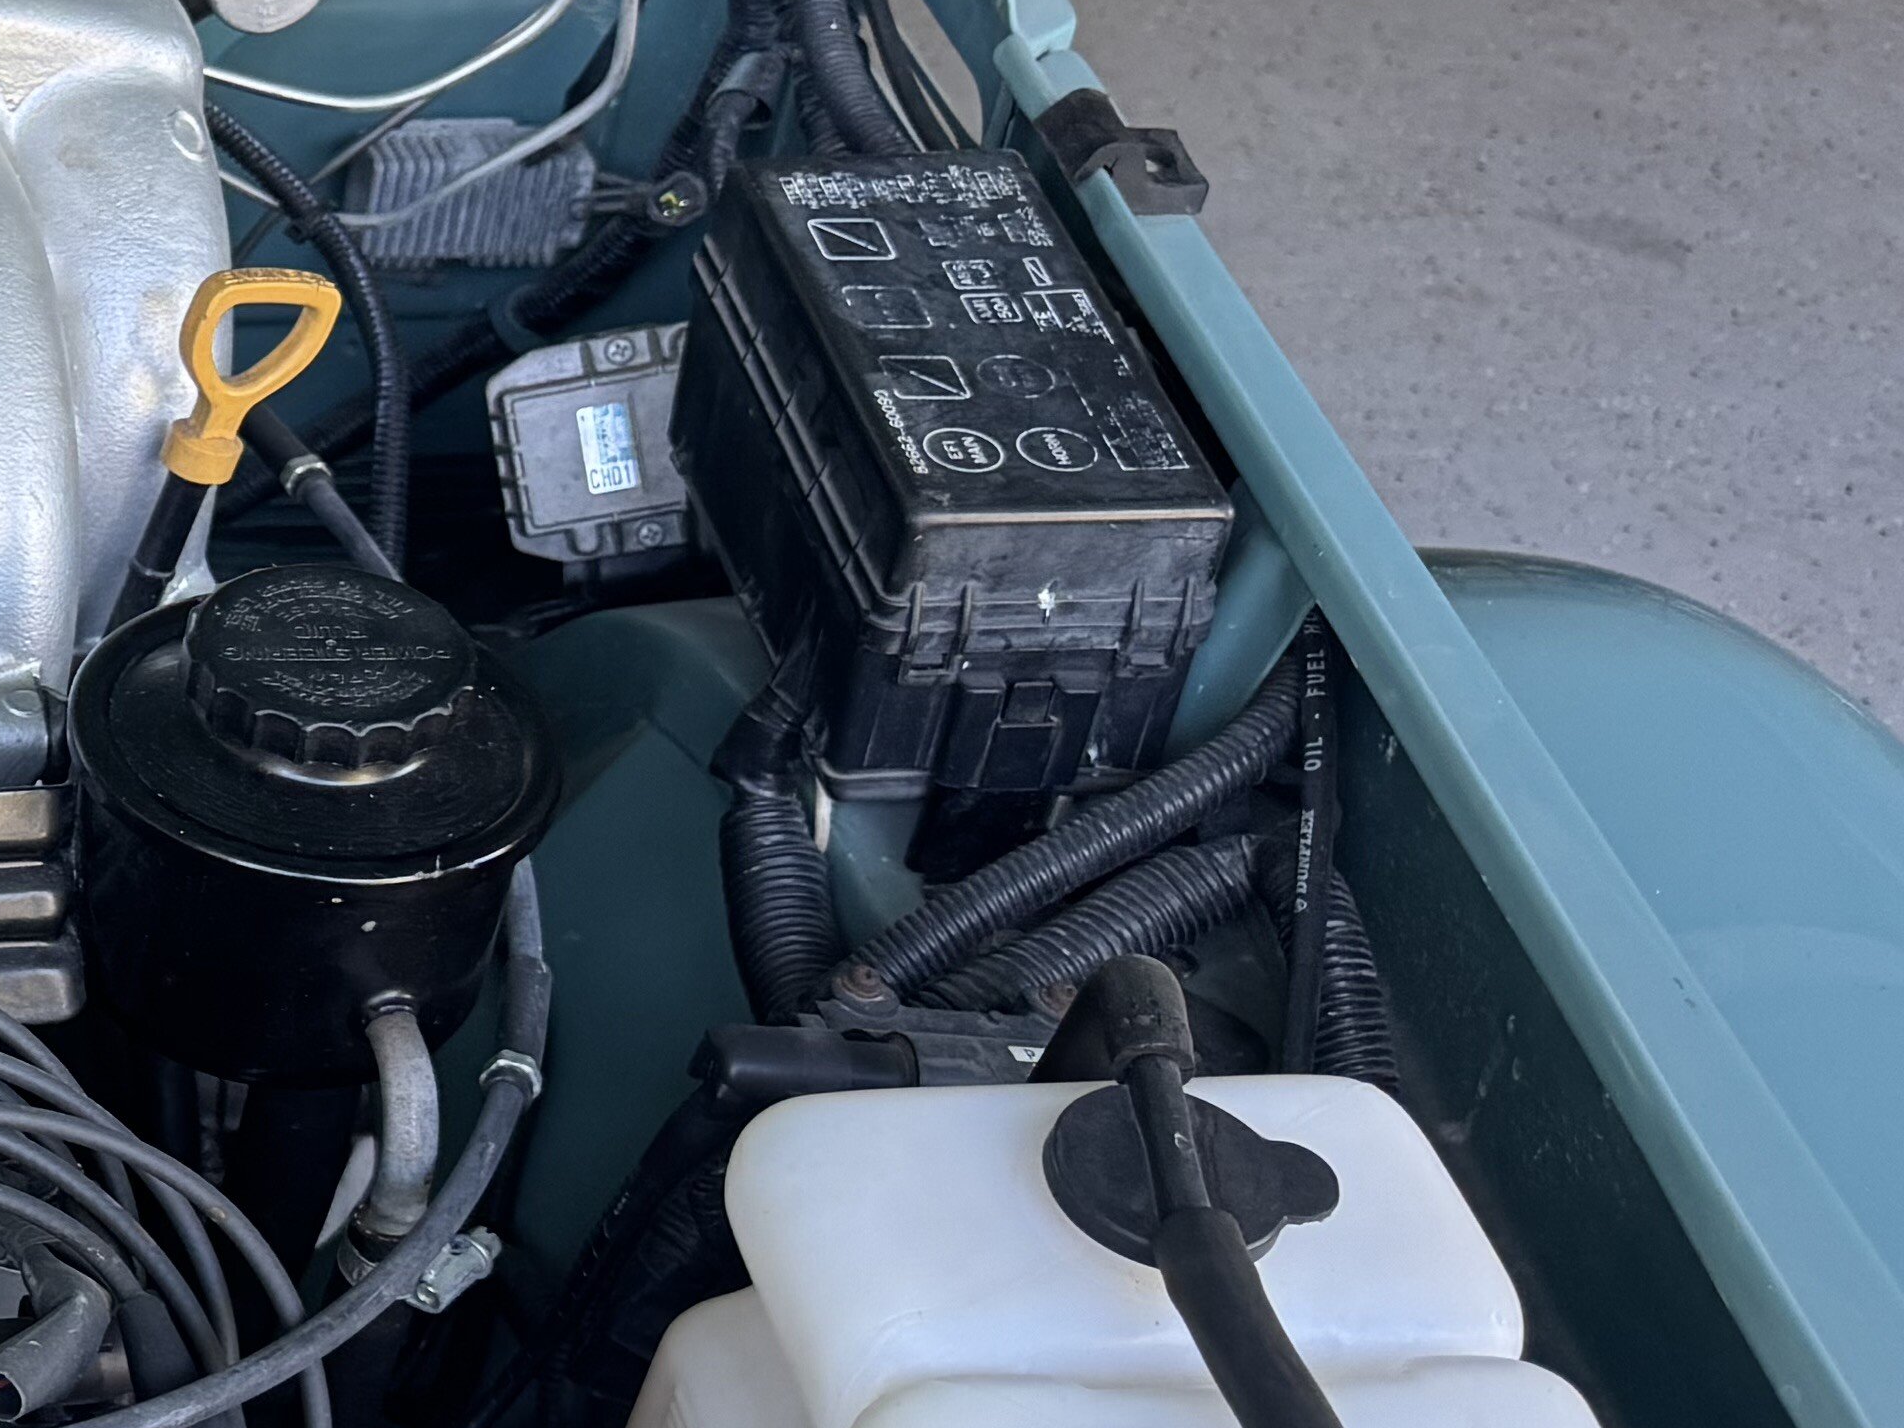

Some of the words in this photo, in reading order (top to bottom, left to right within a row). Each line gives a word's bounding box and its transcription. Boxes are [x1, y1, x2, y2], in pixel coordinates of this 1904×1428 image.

[942, 440, 964, 460] EFI
[961, 436, 988, 464] MAIN
[1042, 433, 1071, 465] HORN
[1306, 648, 1325, 698] FUEL
[1304, 737, 1323, 772] OIL
